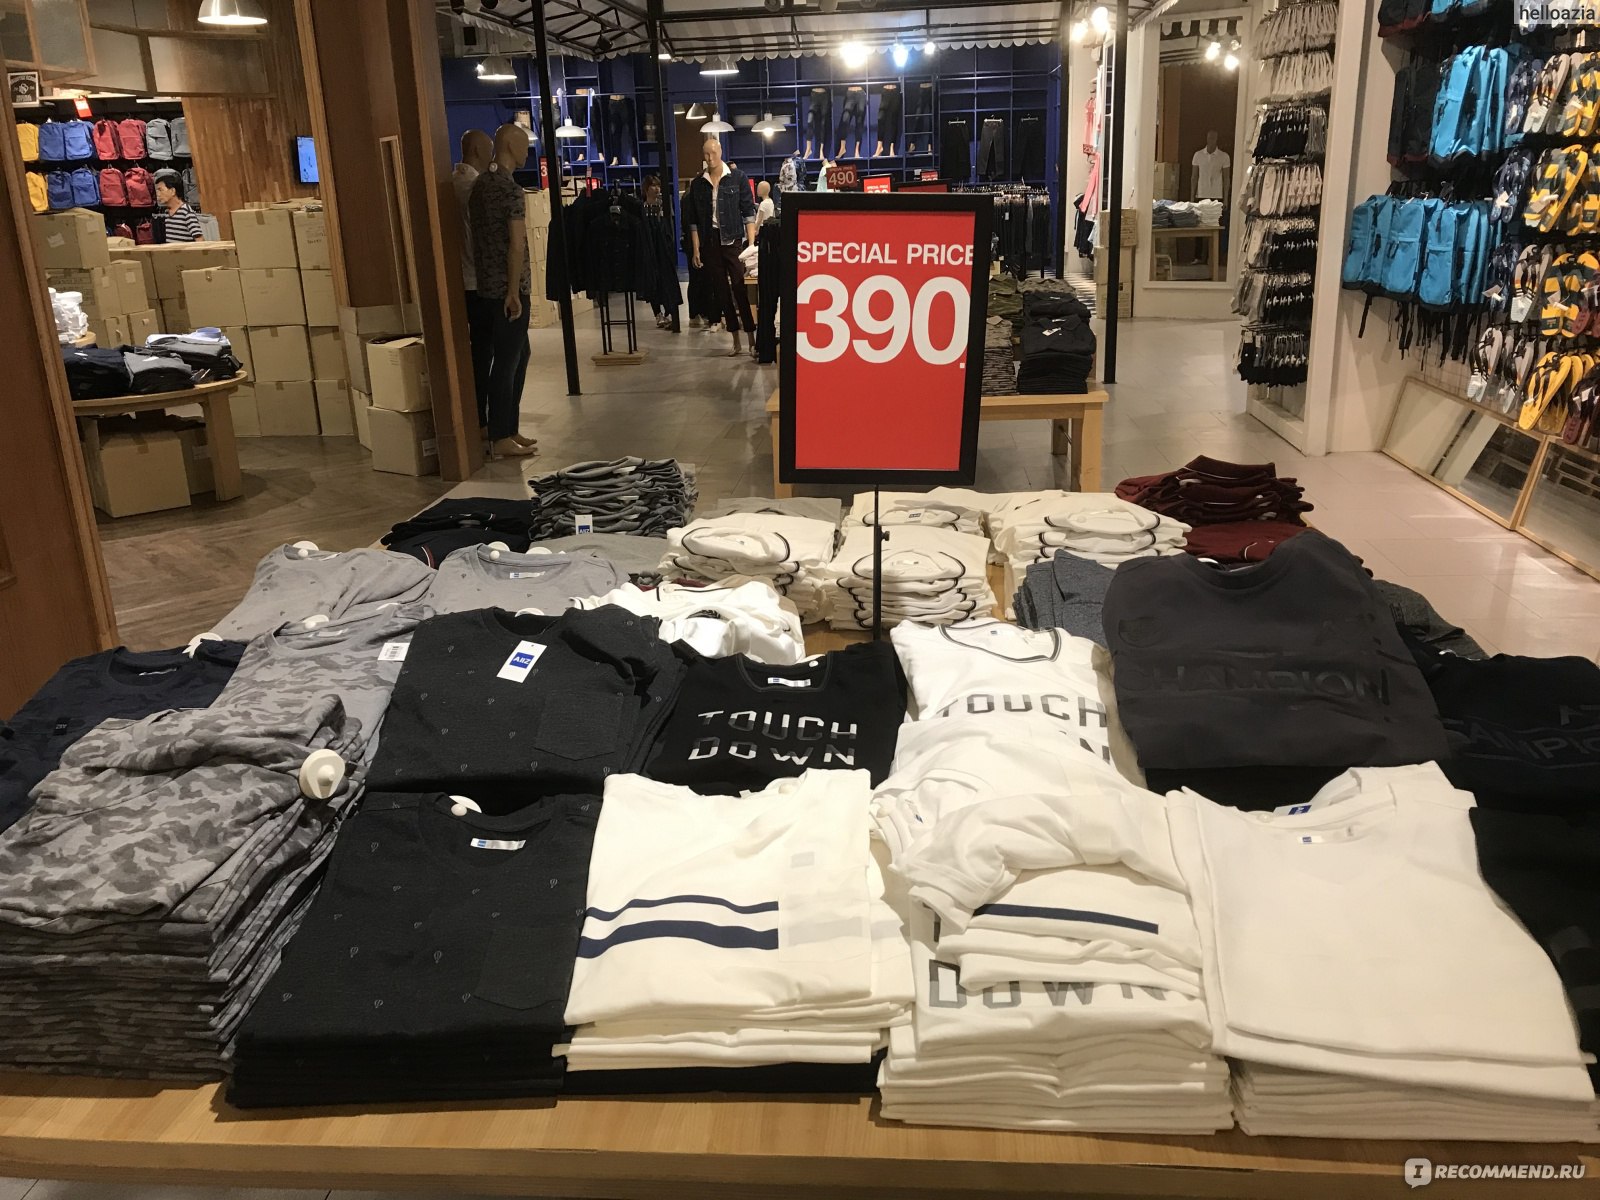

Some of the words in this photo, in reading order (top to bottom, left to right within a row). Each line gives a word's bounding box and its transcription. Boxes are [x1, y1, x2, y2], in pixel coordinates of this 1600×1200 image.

[828, 171, 855, 186] 490
[797, 242, 897, 264] SPECIAL
[906, 244, 974, 265] PRICE
[698, 710, 857, 740] TOUCH
[688, 737, 855, 766] DOWN
